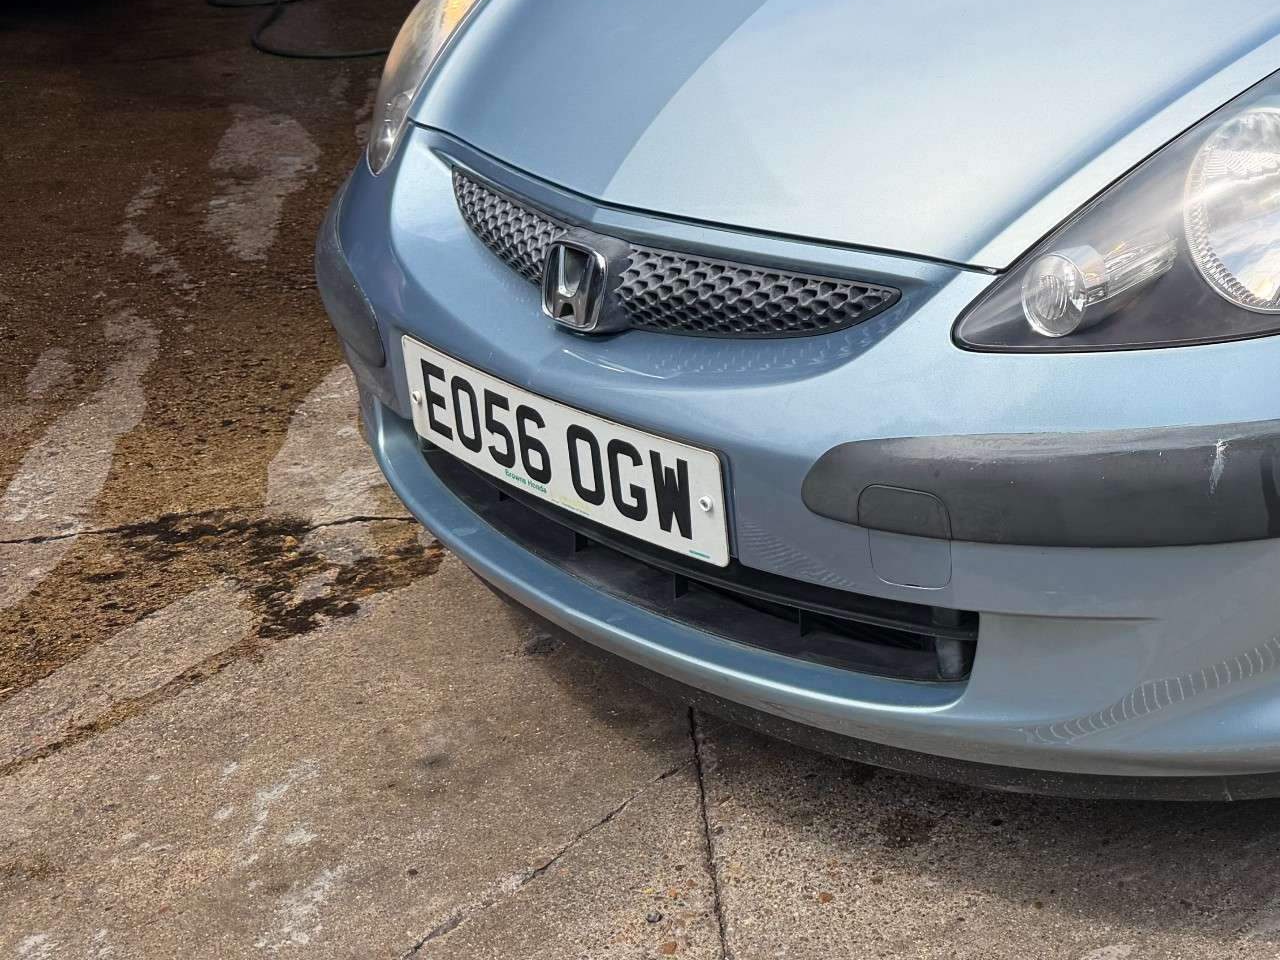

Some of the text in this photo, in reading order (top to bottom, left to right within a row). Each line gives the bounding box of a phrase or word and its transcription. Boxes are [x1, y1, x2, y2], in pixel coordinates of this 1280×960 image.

[420, 358, 693, 541] EO56 OGW
[504, 468, 548, 494] Browns Honda
